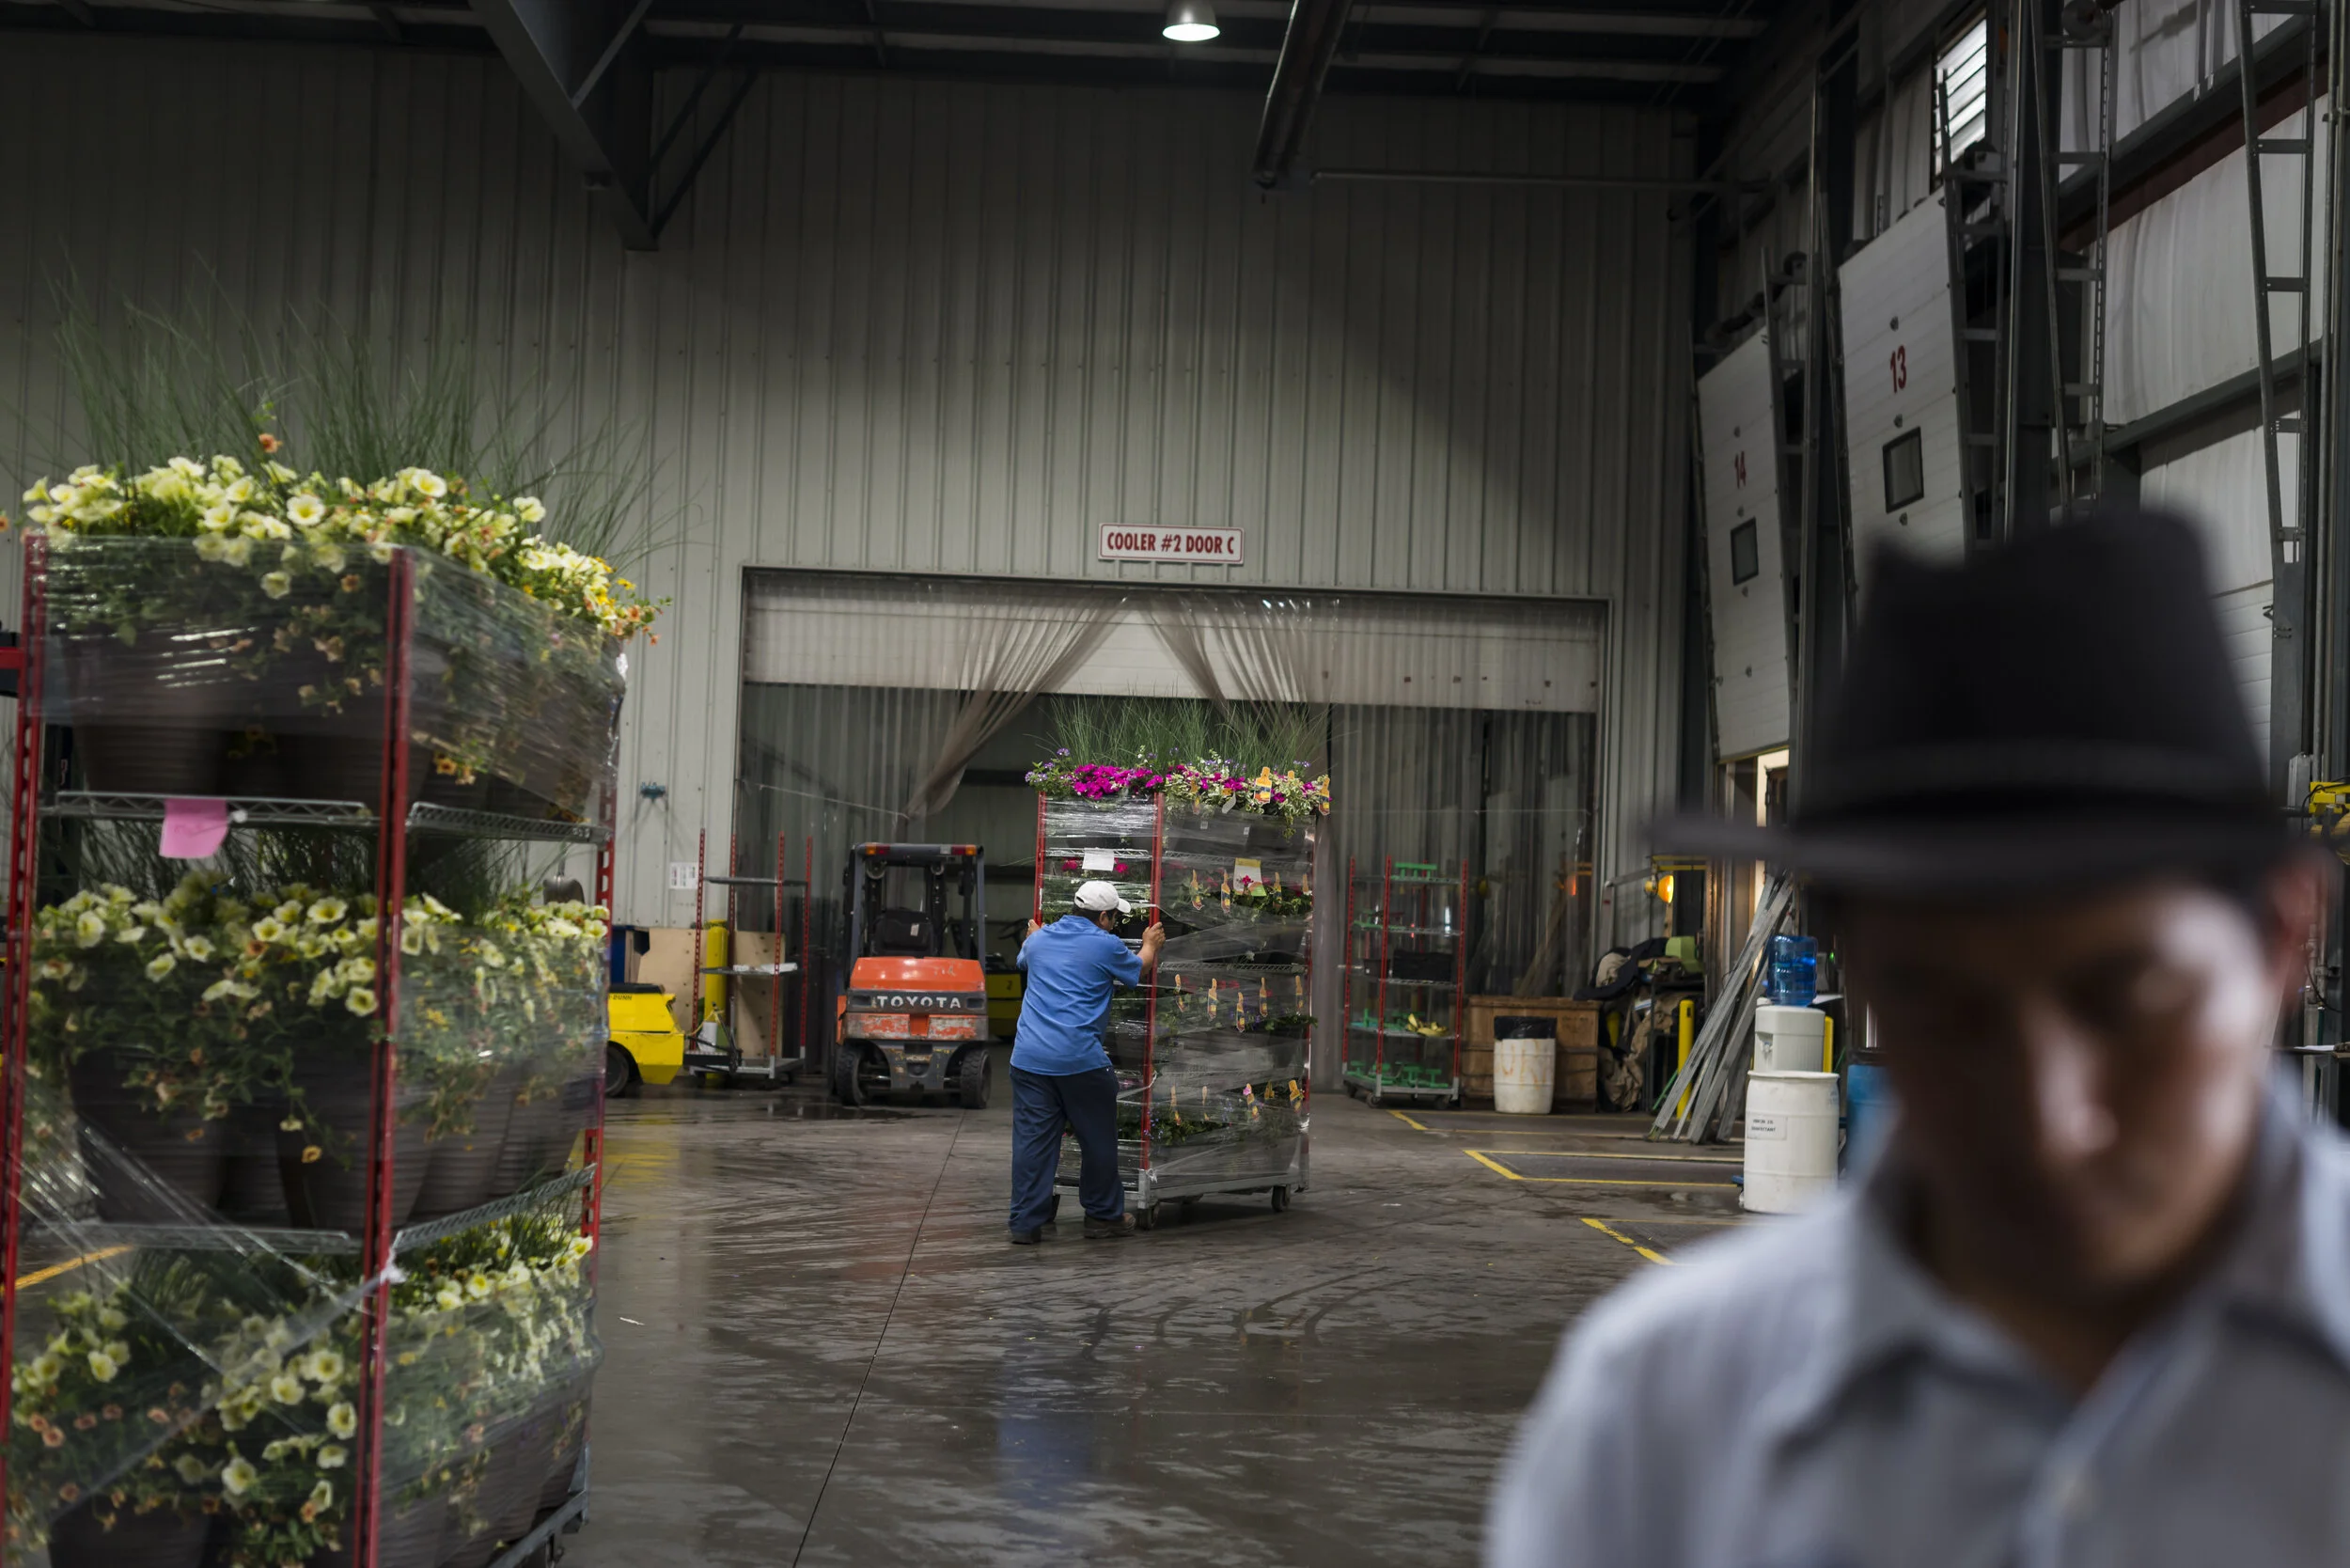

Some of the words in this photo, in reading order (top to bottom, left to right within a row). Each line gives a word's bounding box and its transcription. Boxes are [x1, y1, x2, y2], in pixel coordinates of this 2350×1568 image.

[1890, 344, 1907, 394] 13
[1734, 450, 1747, 489] 14
[1106, 531, 1156, 552] COOLER
[1161, 533, 1182, 553] #2
[1185, 534, 1223, 554] DOOR
[1227, 536, 1234, 555] C
[876, 996, 961, 1009] TOYOTA
